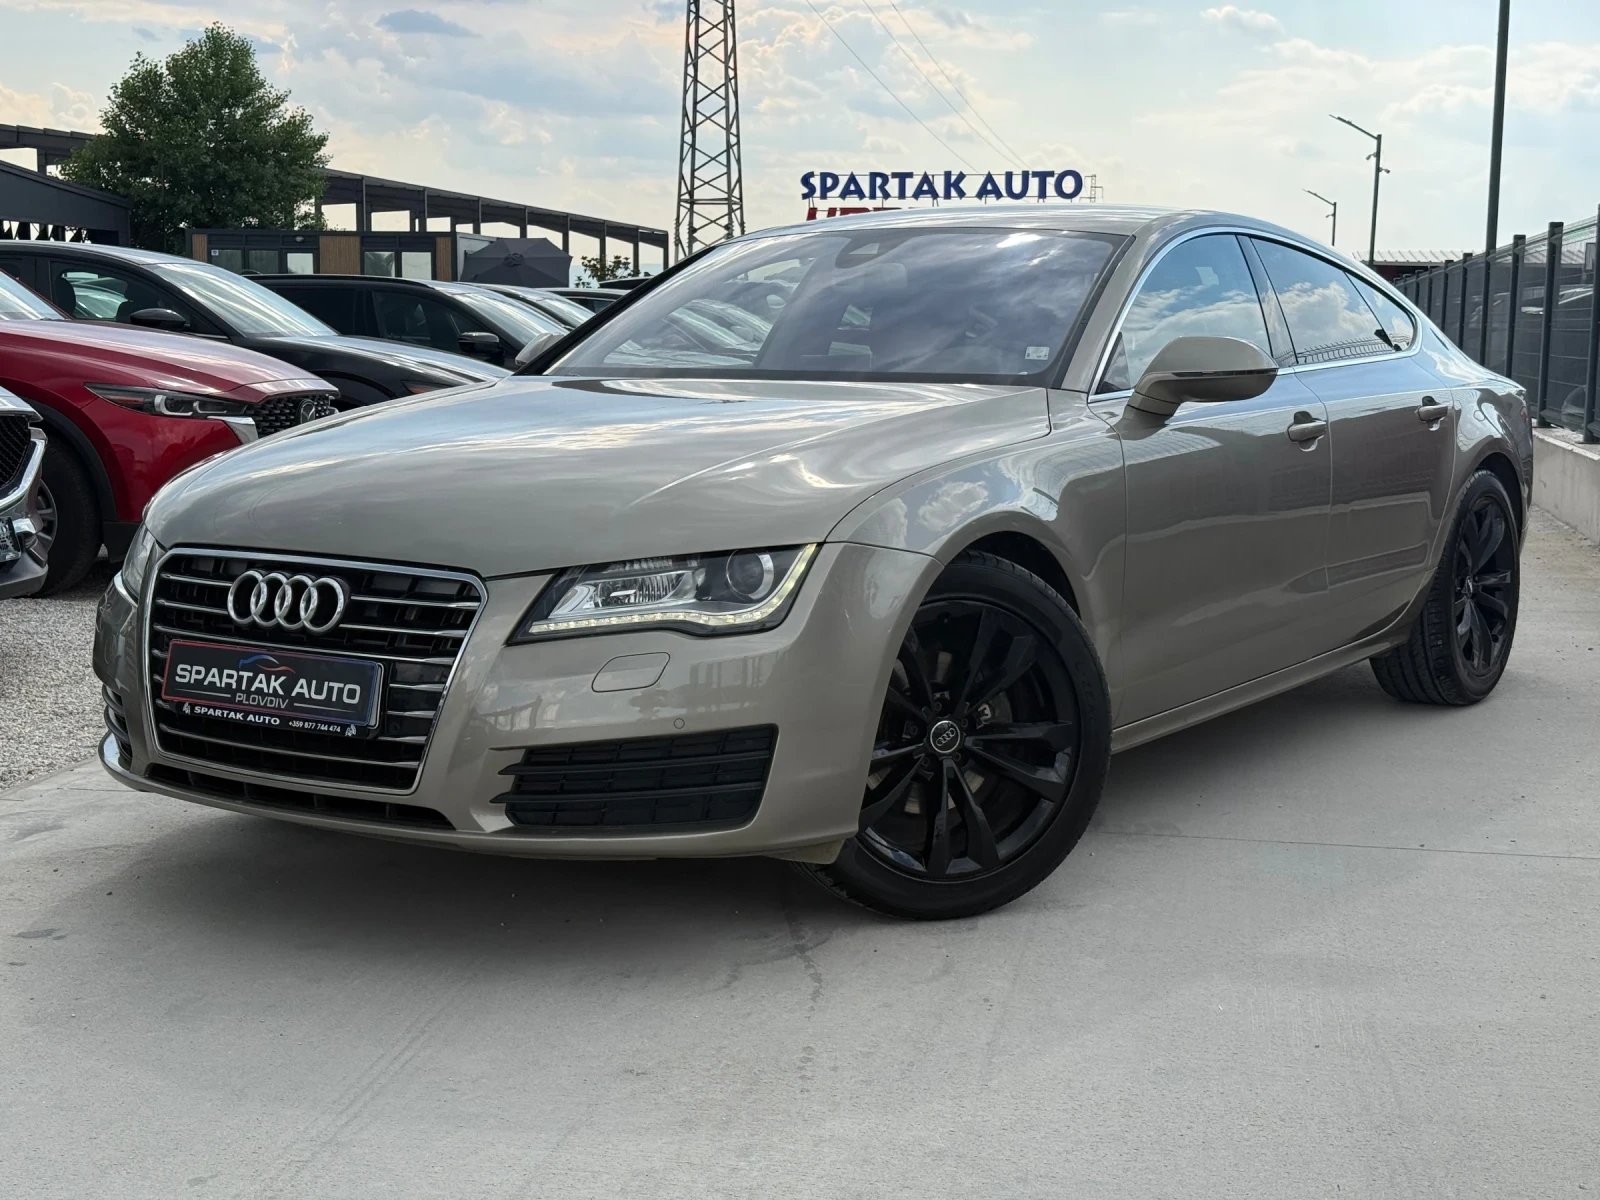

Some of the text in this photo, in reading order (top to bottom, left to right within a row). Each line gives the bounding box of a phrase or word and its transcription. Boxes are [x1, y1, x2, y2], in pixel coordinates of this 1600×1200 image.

[800, 169, 1083, 201] SPARTAK AUTO
[175, 664, 361, 704] SPARTAK AUTO
[235, 692, 289, 709] PLOVDIV
[194, 706, 341, 733] SPARTAK AUTO +359 877 744 474
